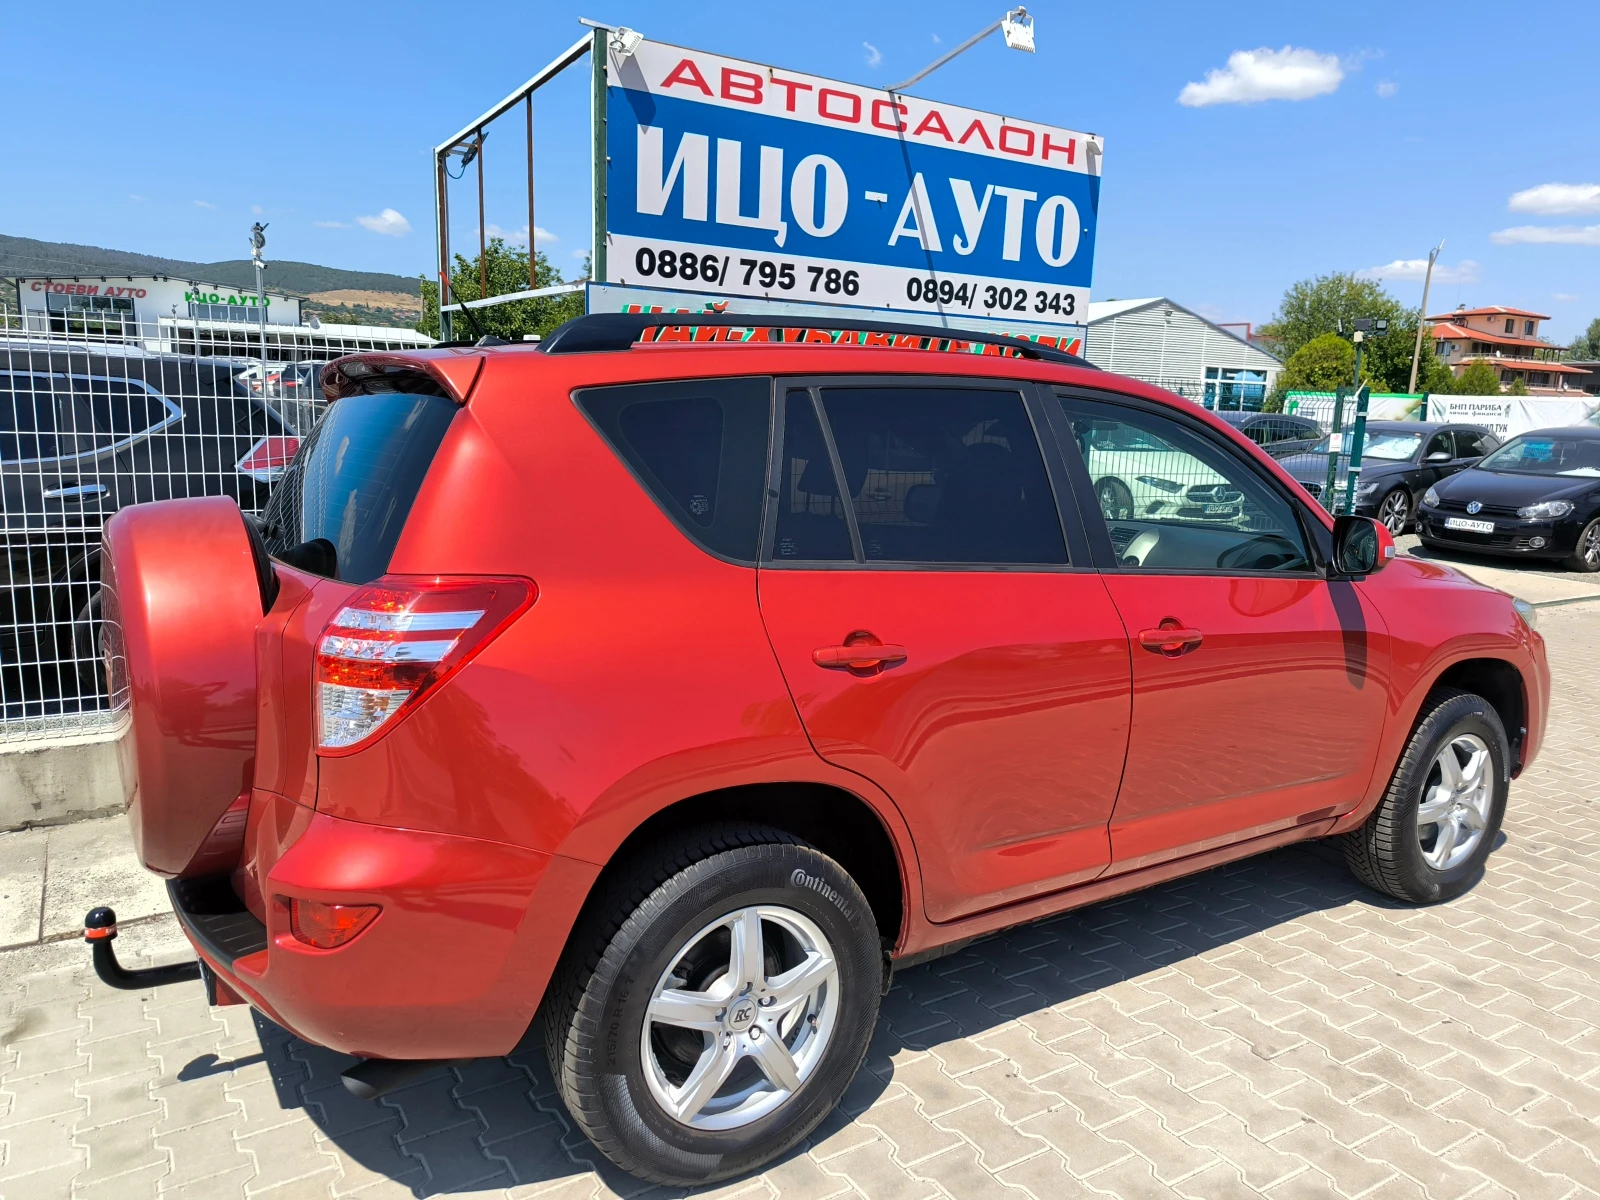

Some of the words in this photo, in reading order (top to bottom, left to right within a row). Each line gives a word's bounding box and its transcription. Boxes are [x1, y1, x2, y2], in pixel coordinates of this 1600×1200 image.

[660, 59, 1076, 165] АВТОСАЛОН
[30, 281, 99, 295] СТОЕВИ
[104, 286, 147, 299] АУТО
[635, 247, 730, 286] 0886/
[739, 257, 796, 290] 795
[807, 265, 860, 296] 786
[906, 276, 978, 310] 0894/
[983, 285, 1028, 312] 302
[1034, 290, 1076, 316] 343
[1449, 403, 1467, 411] БНП
[1468, 404, 1502, 412] ПАРИБА
[1449, 519, 1493, 531] ИЦО-АУТО
[790, 868, 858, 923] Continental
[607, 1022, 620, 1066] 215/70
